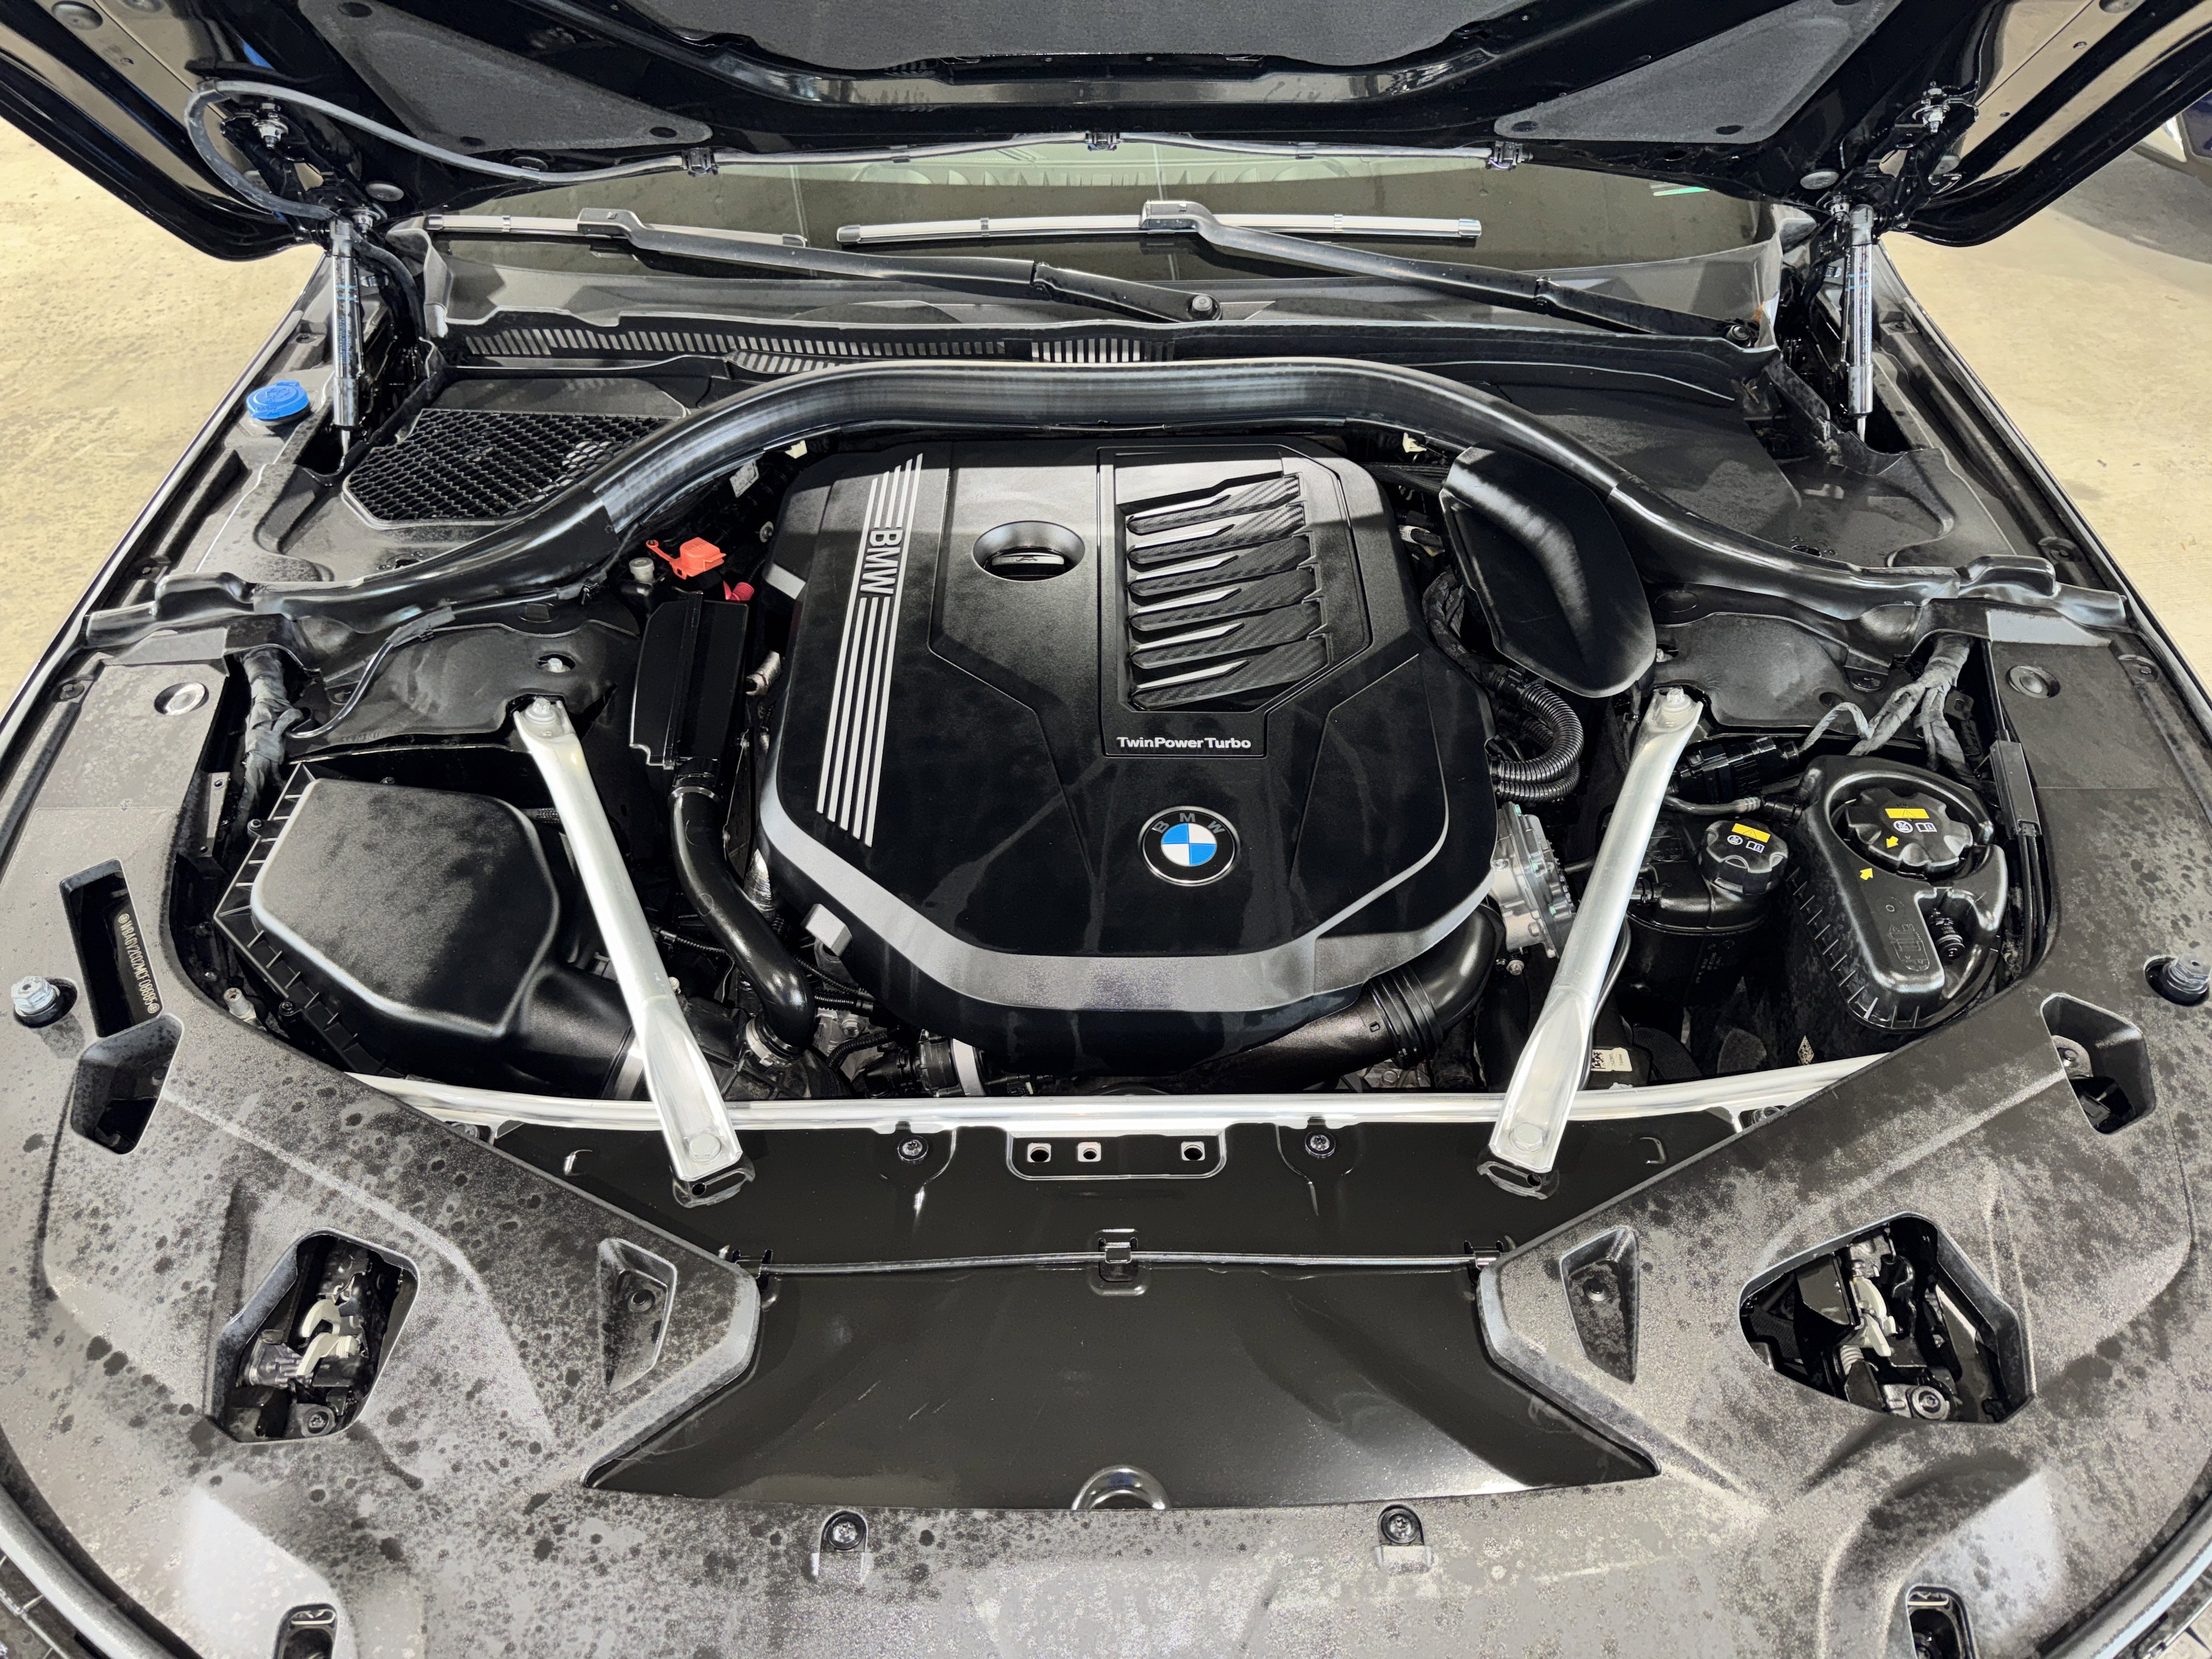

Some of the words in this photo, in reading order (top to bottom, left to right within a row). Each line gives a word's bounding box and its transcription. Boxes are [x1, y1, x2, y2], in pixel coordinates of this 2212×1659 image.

[860, 529, 904, 594] BMW
[1116, 737, 1203, 748] TwinPower
[1204, 737, 1251, 748] Turbo
[1152, 812, 1226, 834] BMW
